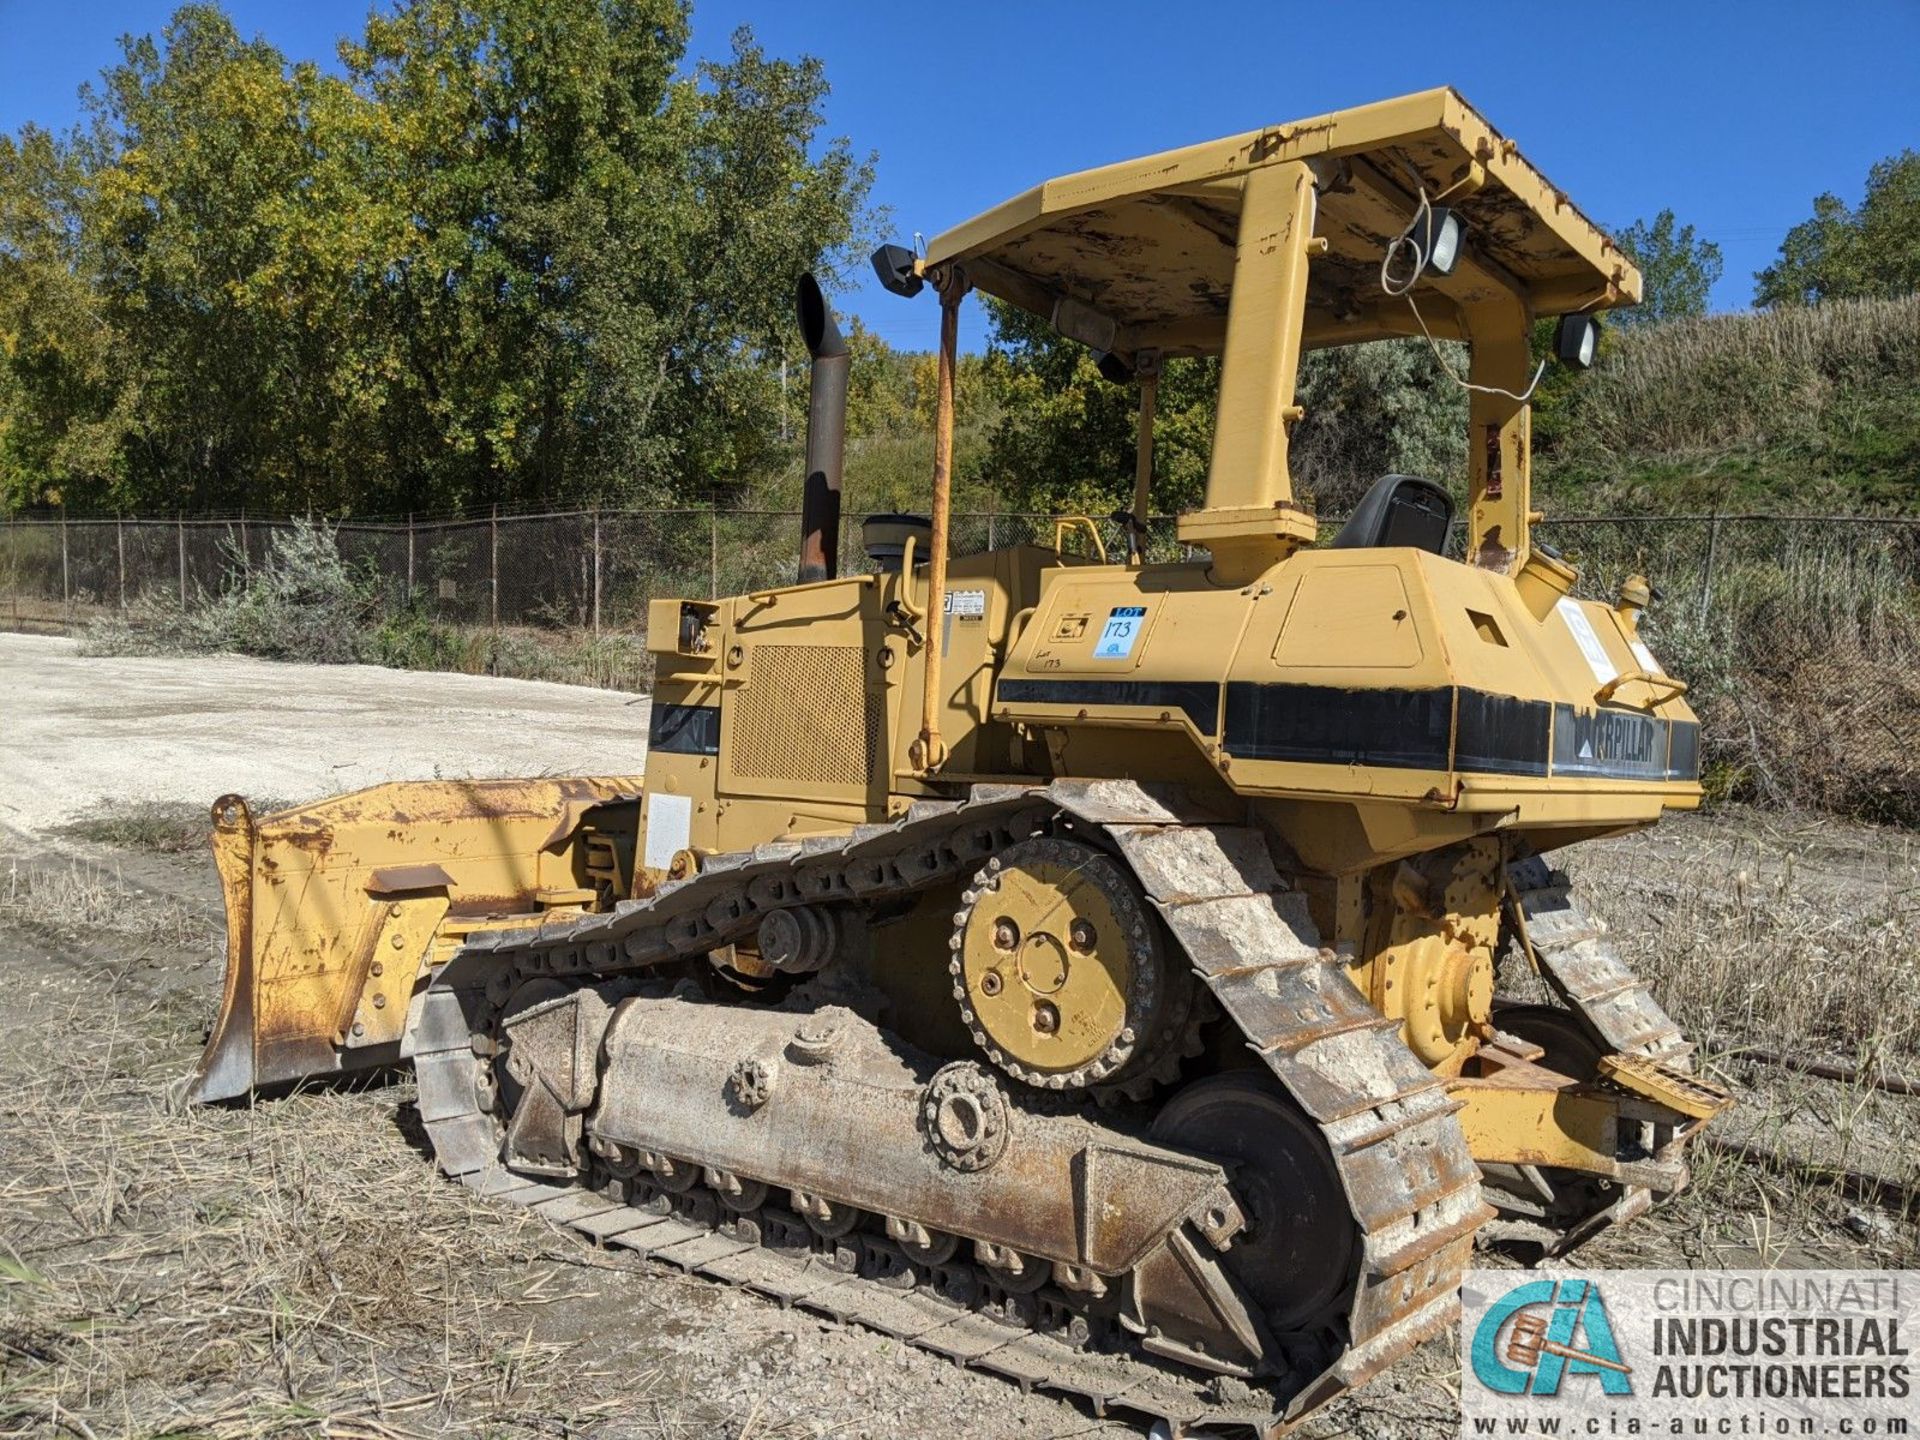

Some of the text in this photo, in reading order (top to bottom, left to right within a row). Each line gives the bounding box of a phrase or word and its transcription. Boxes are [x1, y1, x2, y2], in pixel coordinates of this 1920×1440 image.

[1115, 607, 1143, 617] LOT
[1104, 621, 1132, 639] 173
[1043, 659, 1061, 669] 173
